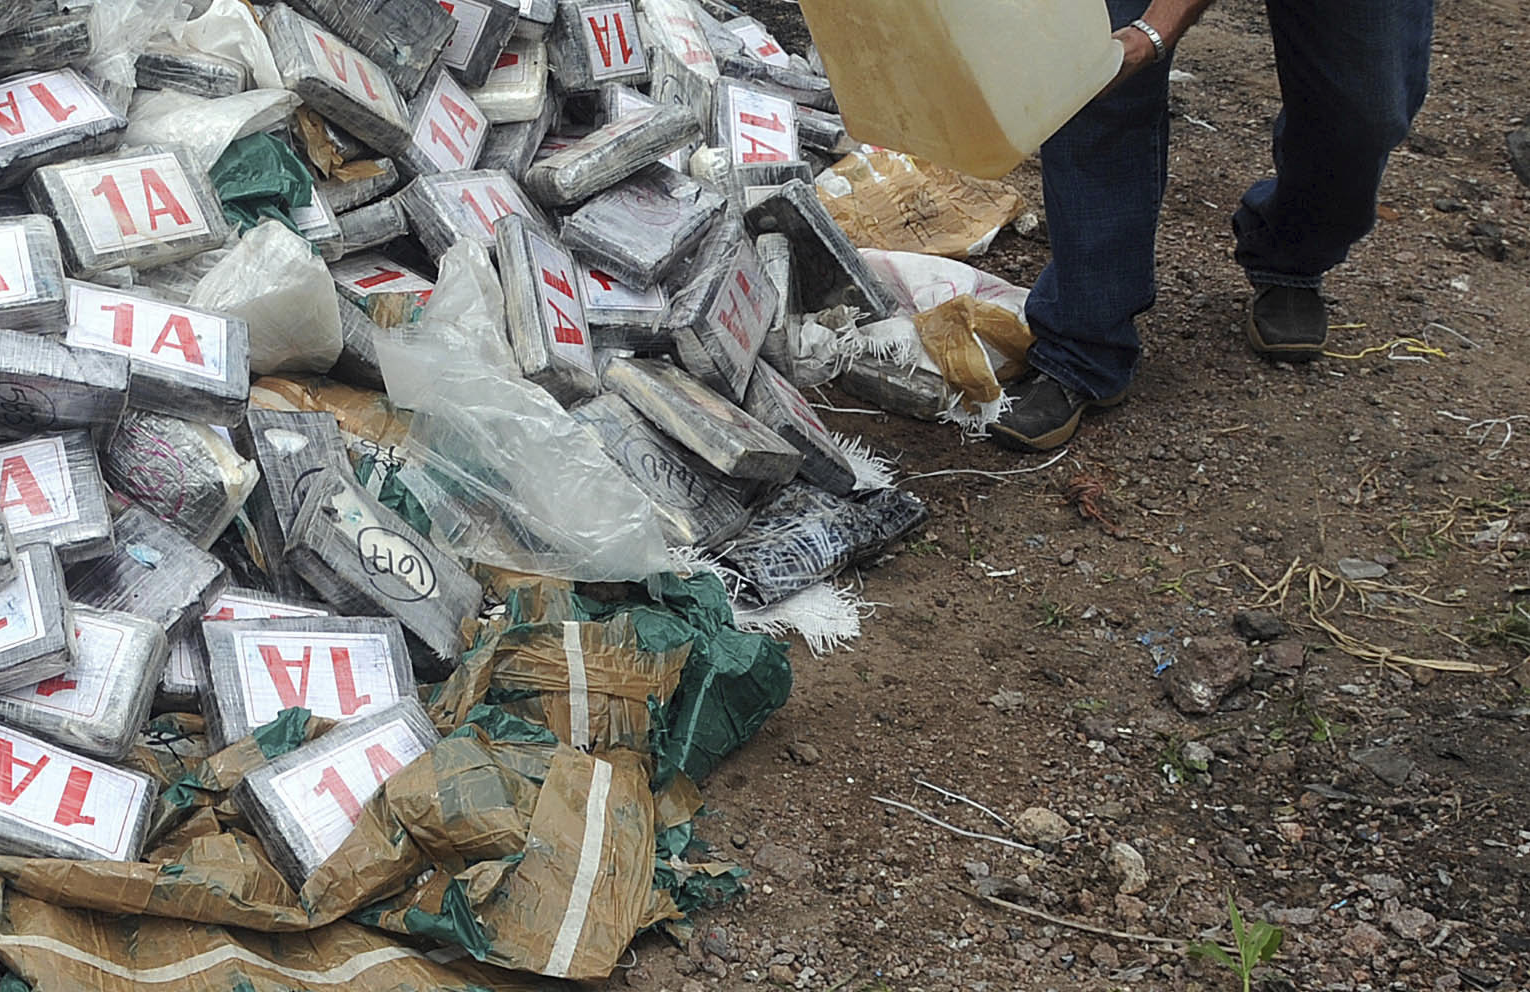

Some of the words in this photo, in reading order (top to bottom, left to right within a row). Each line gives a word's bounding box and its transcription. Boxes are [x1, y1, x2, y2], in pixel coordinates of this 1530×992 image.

[314, 33, 380, 101] 1A
[588, 12, 634, 68] 1A
[429, 93, 479, 166] 1A
[740, 111, 788, 163] 1A
[91, 167, 192, 237] 1A
[101, 303, 206, 367] 1A
[542, 268, 585, 346] 1A
[257, 644, 372, 716] 1A
